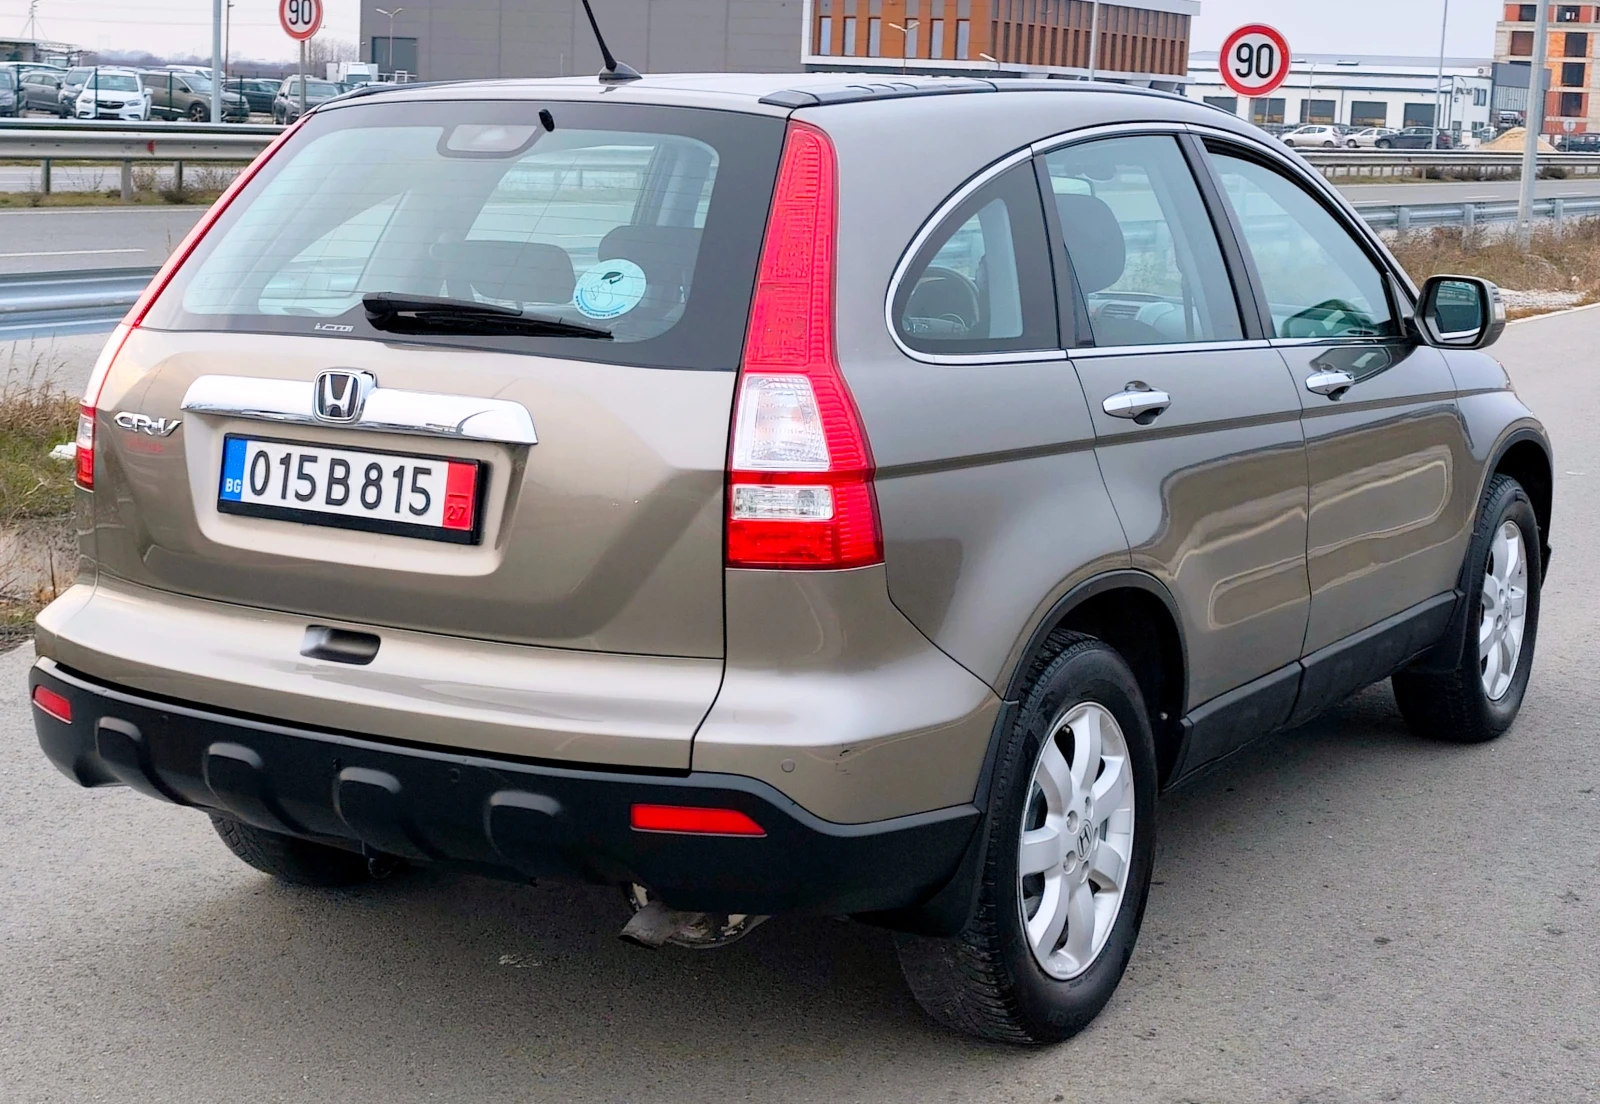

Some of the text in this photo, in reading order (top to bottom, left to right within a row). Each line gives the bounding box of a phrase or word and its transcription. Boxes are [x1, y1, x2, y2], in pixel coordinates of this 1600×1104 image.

[289, 0, 312, 25] 90
[1235, 43, 1274, 78] 90
[114, 411, 182, 437] CR-V
[225, 478, 241, 493] BG
[250, 450, 432, 516] 015B815
[446, 503, 468, 521] 27
